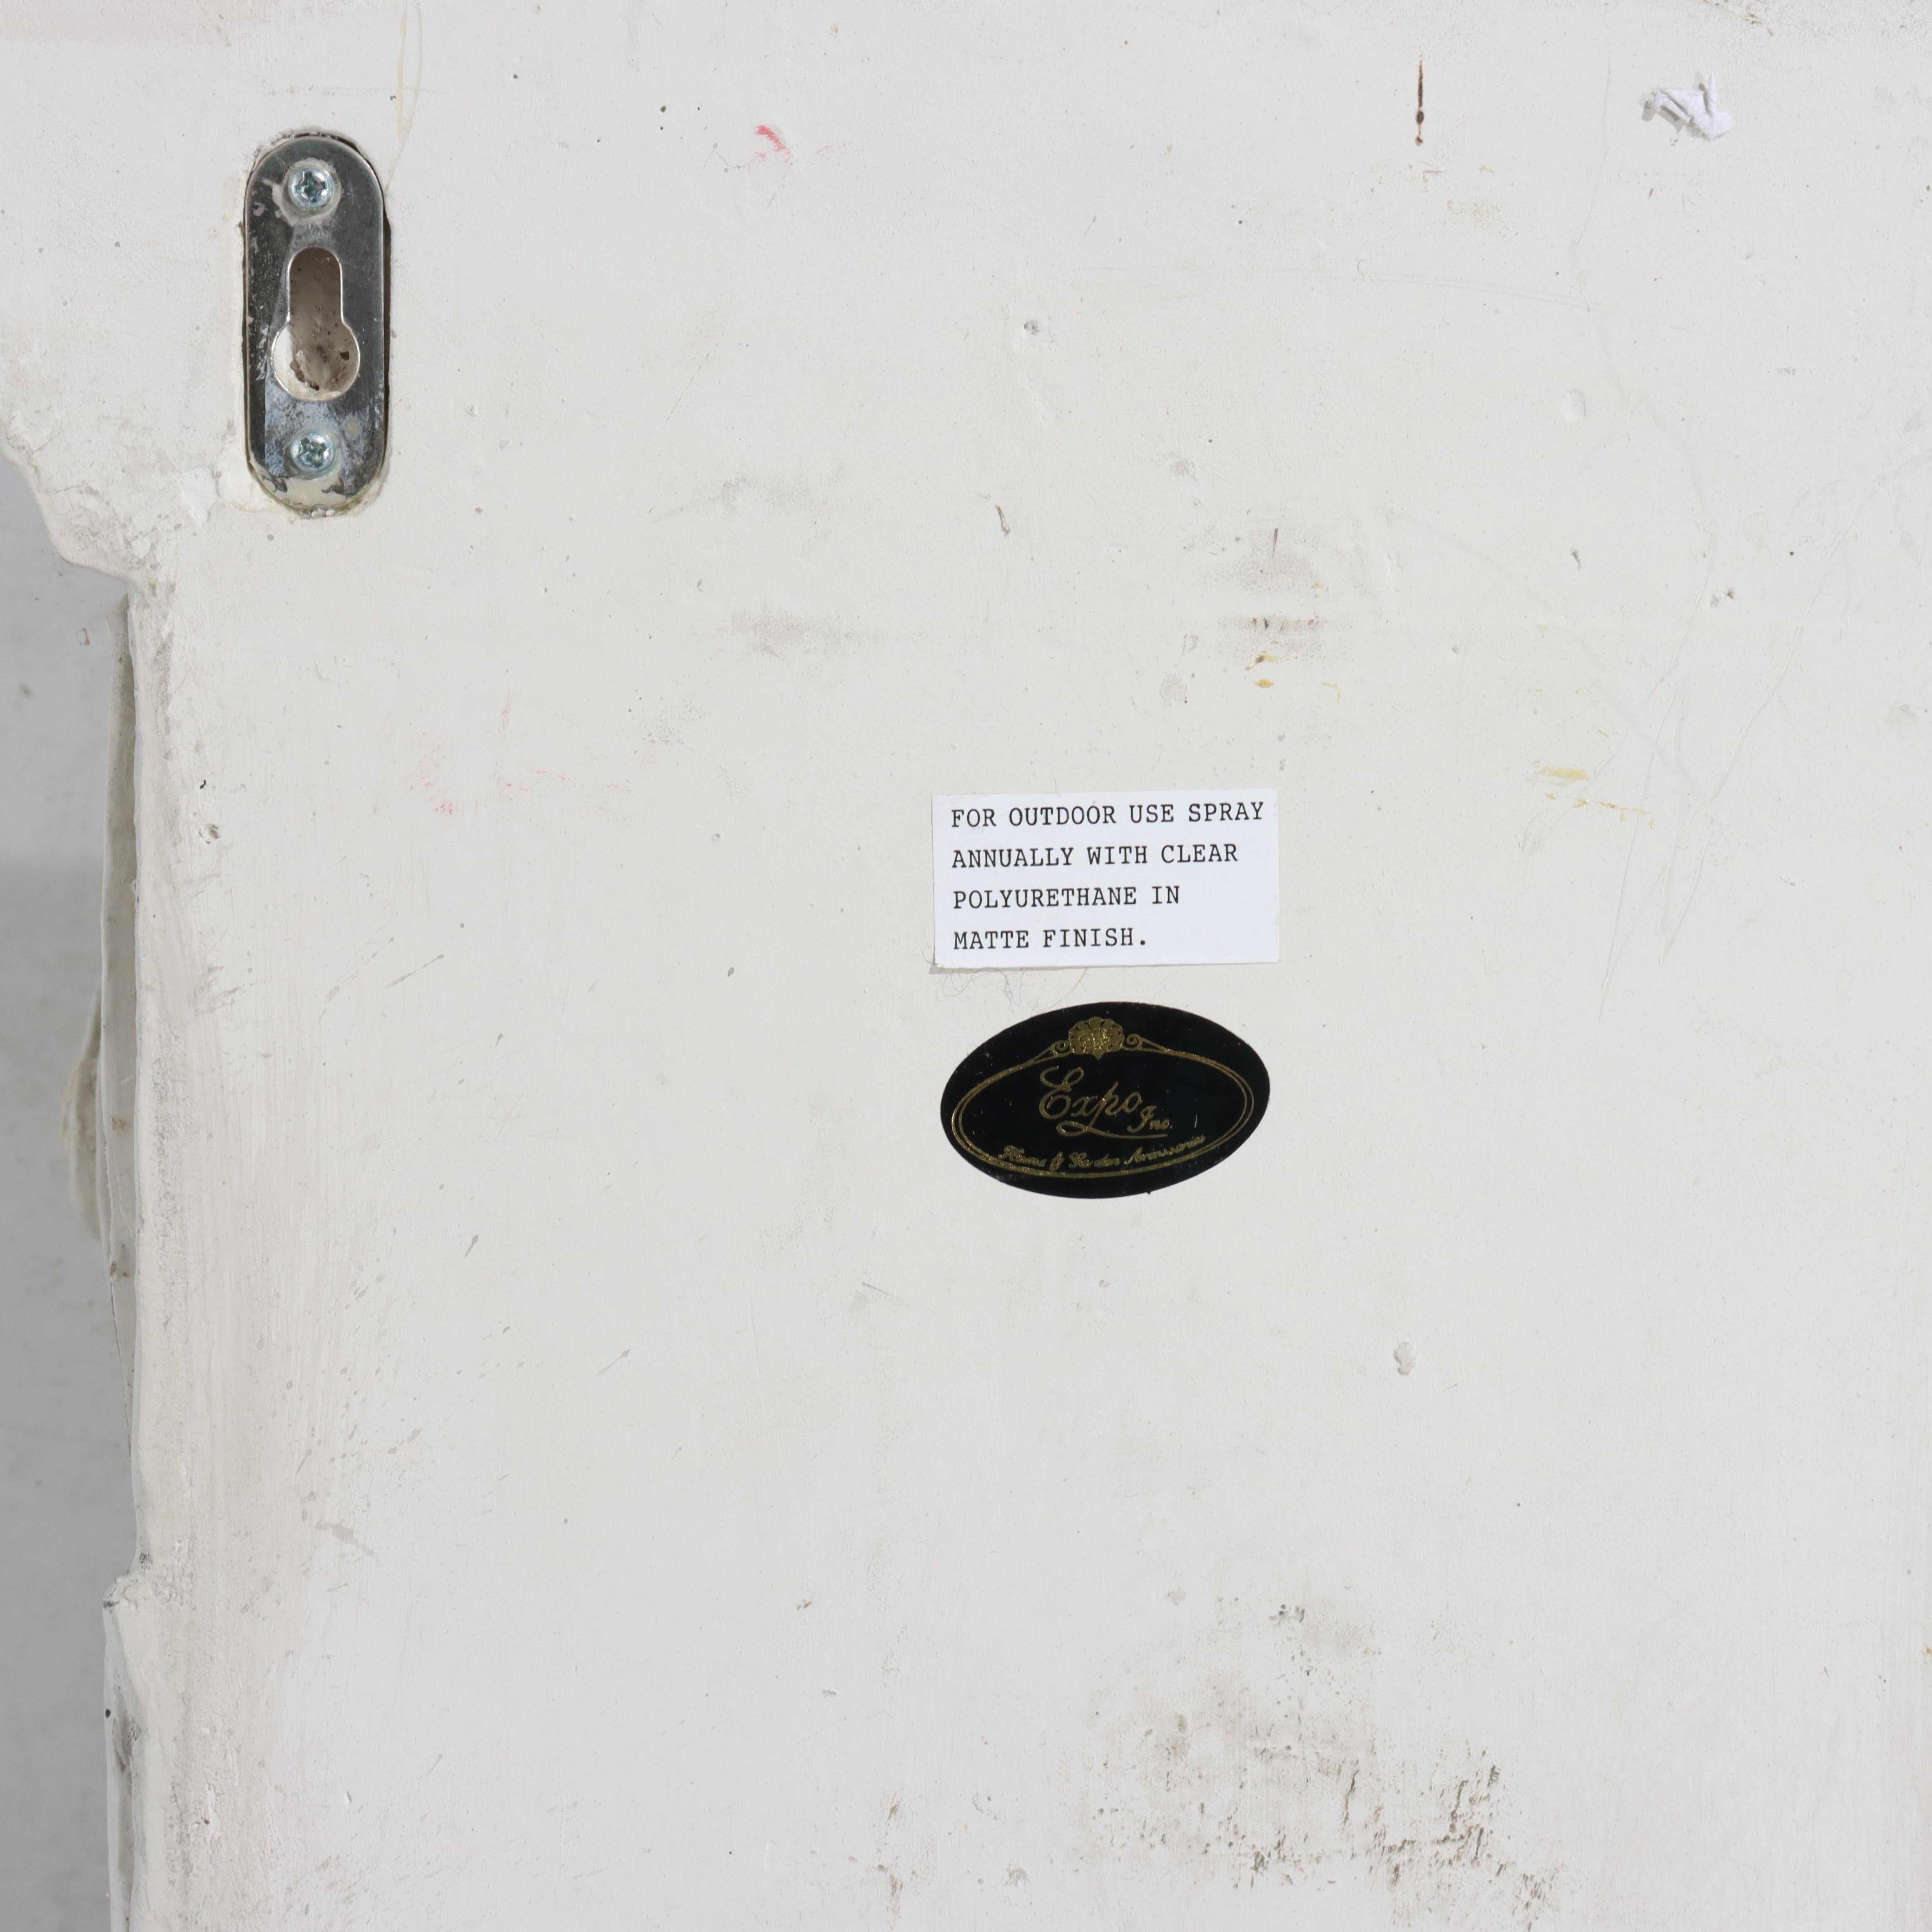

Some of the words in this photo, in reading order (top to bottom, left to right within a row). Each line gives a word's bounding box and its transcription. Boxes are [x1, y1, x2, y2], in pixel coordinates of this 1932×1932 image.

[951, 809, 996, 827] FOR
[1009, 806, 1116, 826] OUTDOOR
[1129, 804, 1174, 823] USE
[1189, 802, 1263, 822] SPRAY
[952, 847, 1073, 868] ANNUALLY
[1087, 846, 1147, 865] WITH
[1161, 844, 1238, 863] CLEAR
[954, 886, 1136, 909] POLYURETHANE
[1152, 886, 1179, 904] IN
[954, 930, 1029, 949] MATTE
[1043, 928, 1145, 948] FINISH.
[1039, 1066, 1144, 1138] Expo
